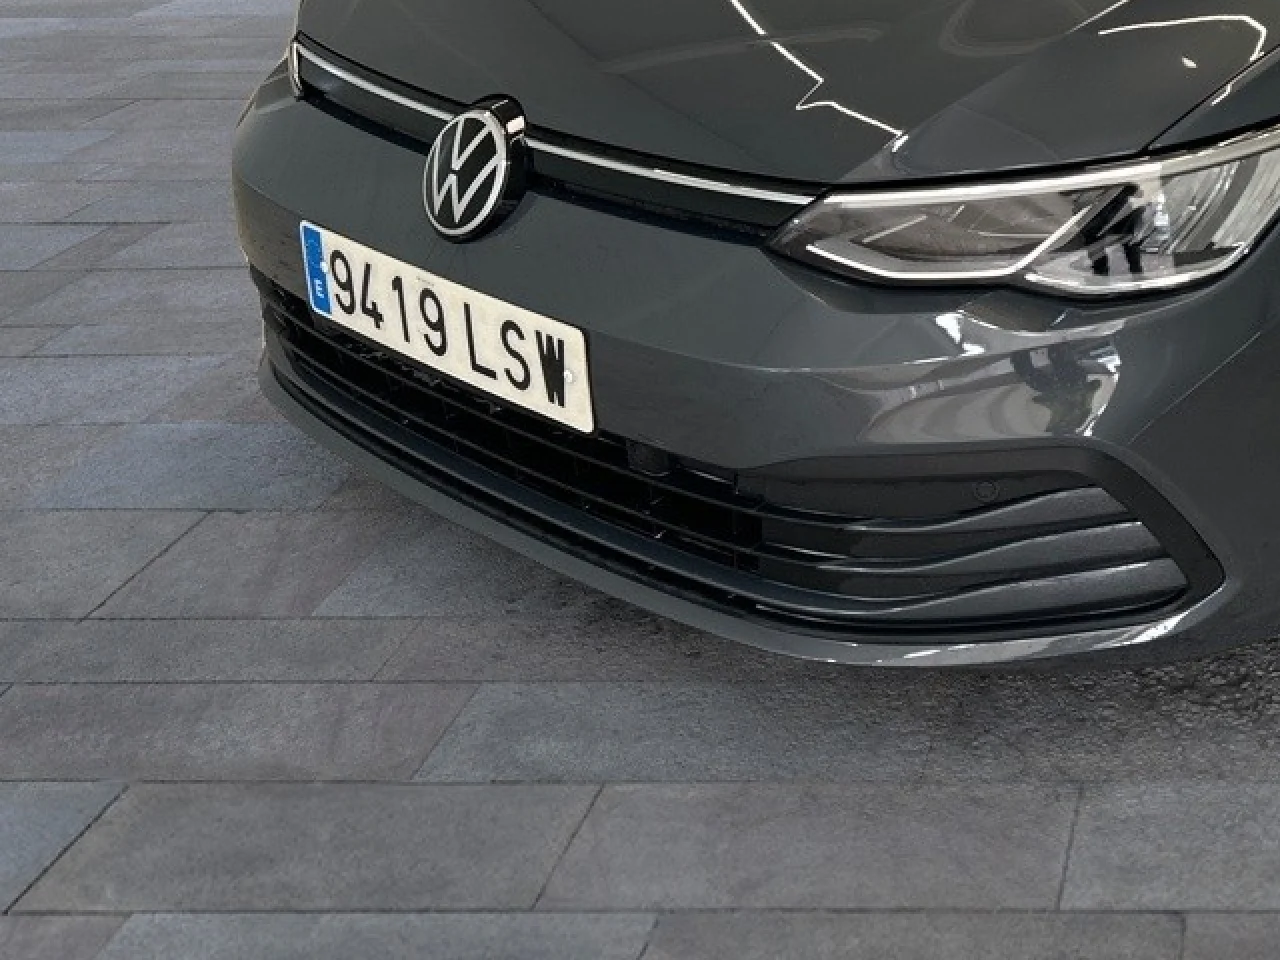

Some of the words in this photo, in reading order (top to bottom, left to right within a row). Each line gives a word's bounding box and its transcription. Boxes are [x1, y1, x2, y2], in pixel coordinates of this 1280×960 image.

[314, 278, 325, 299] E
[329, 250, 448, 357] 9419
[464, 301, 565, 408] LSW
